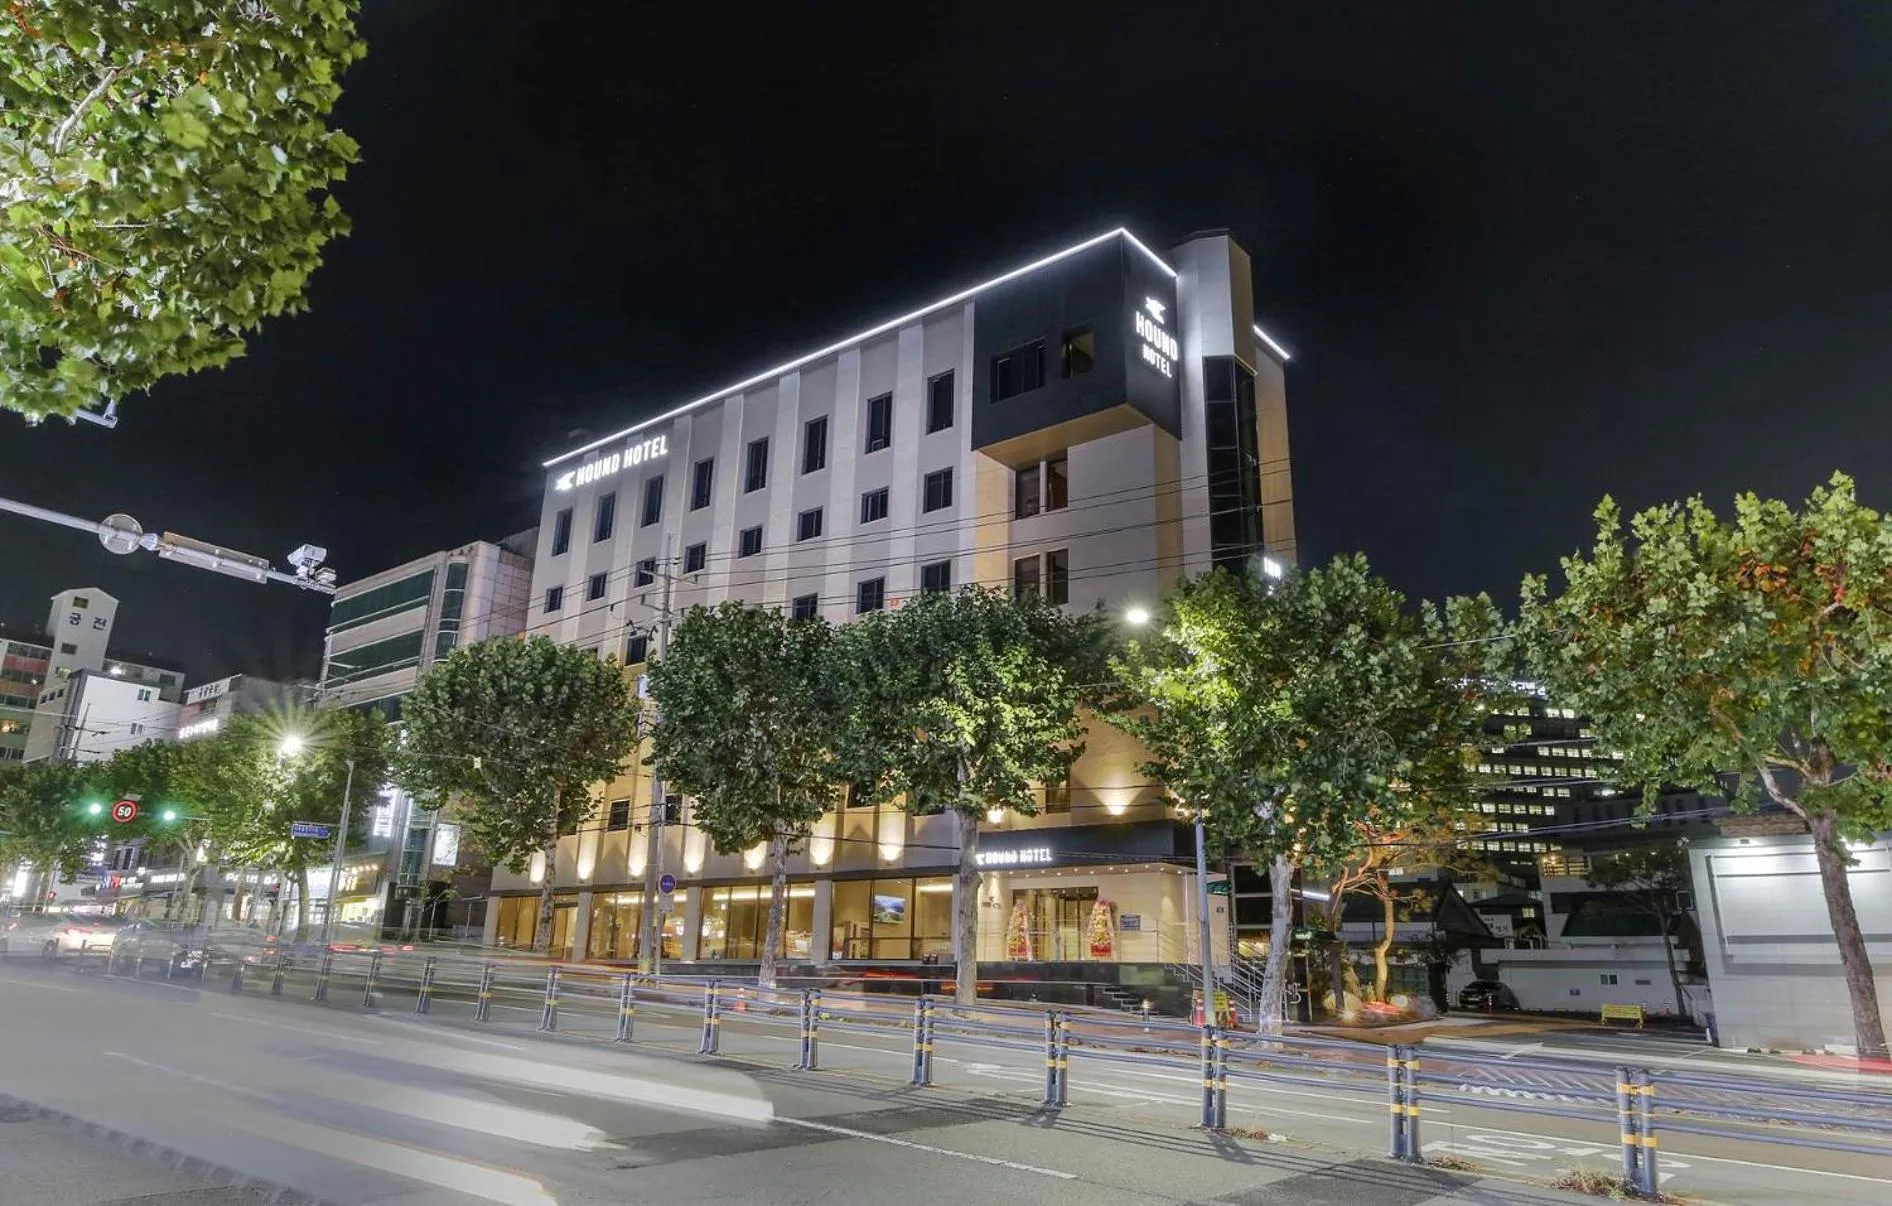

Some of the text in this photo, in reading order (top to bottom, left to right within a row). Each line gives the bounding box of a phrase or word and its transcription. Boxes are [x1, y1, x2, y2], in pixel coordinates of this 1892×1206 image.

[1136, 310, 1178, 361] HOUND
[1143, 343, 1173, 378] HOTEL
[576, 434, 669, 487] HOUND HOTEL
[985, 847, 1053, 865] HOUND HOTEL
